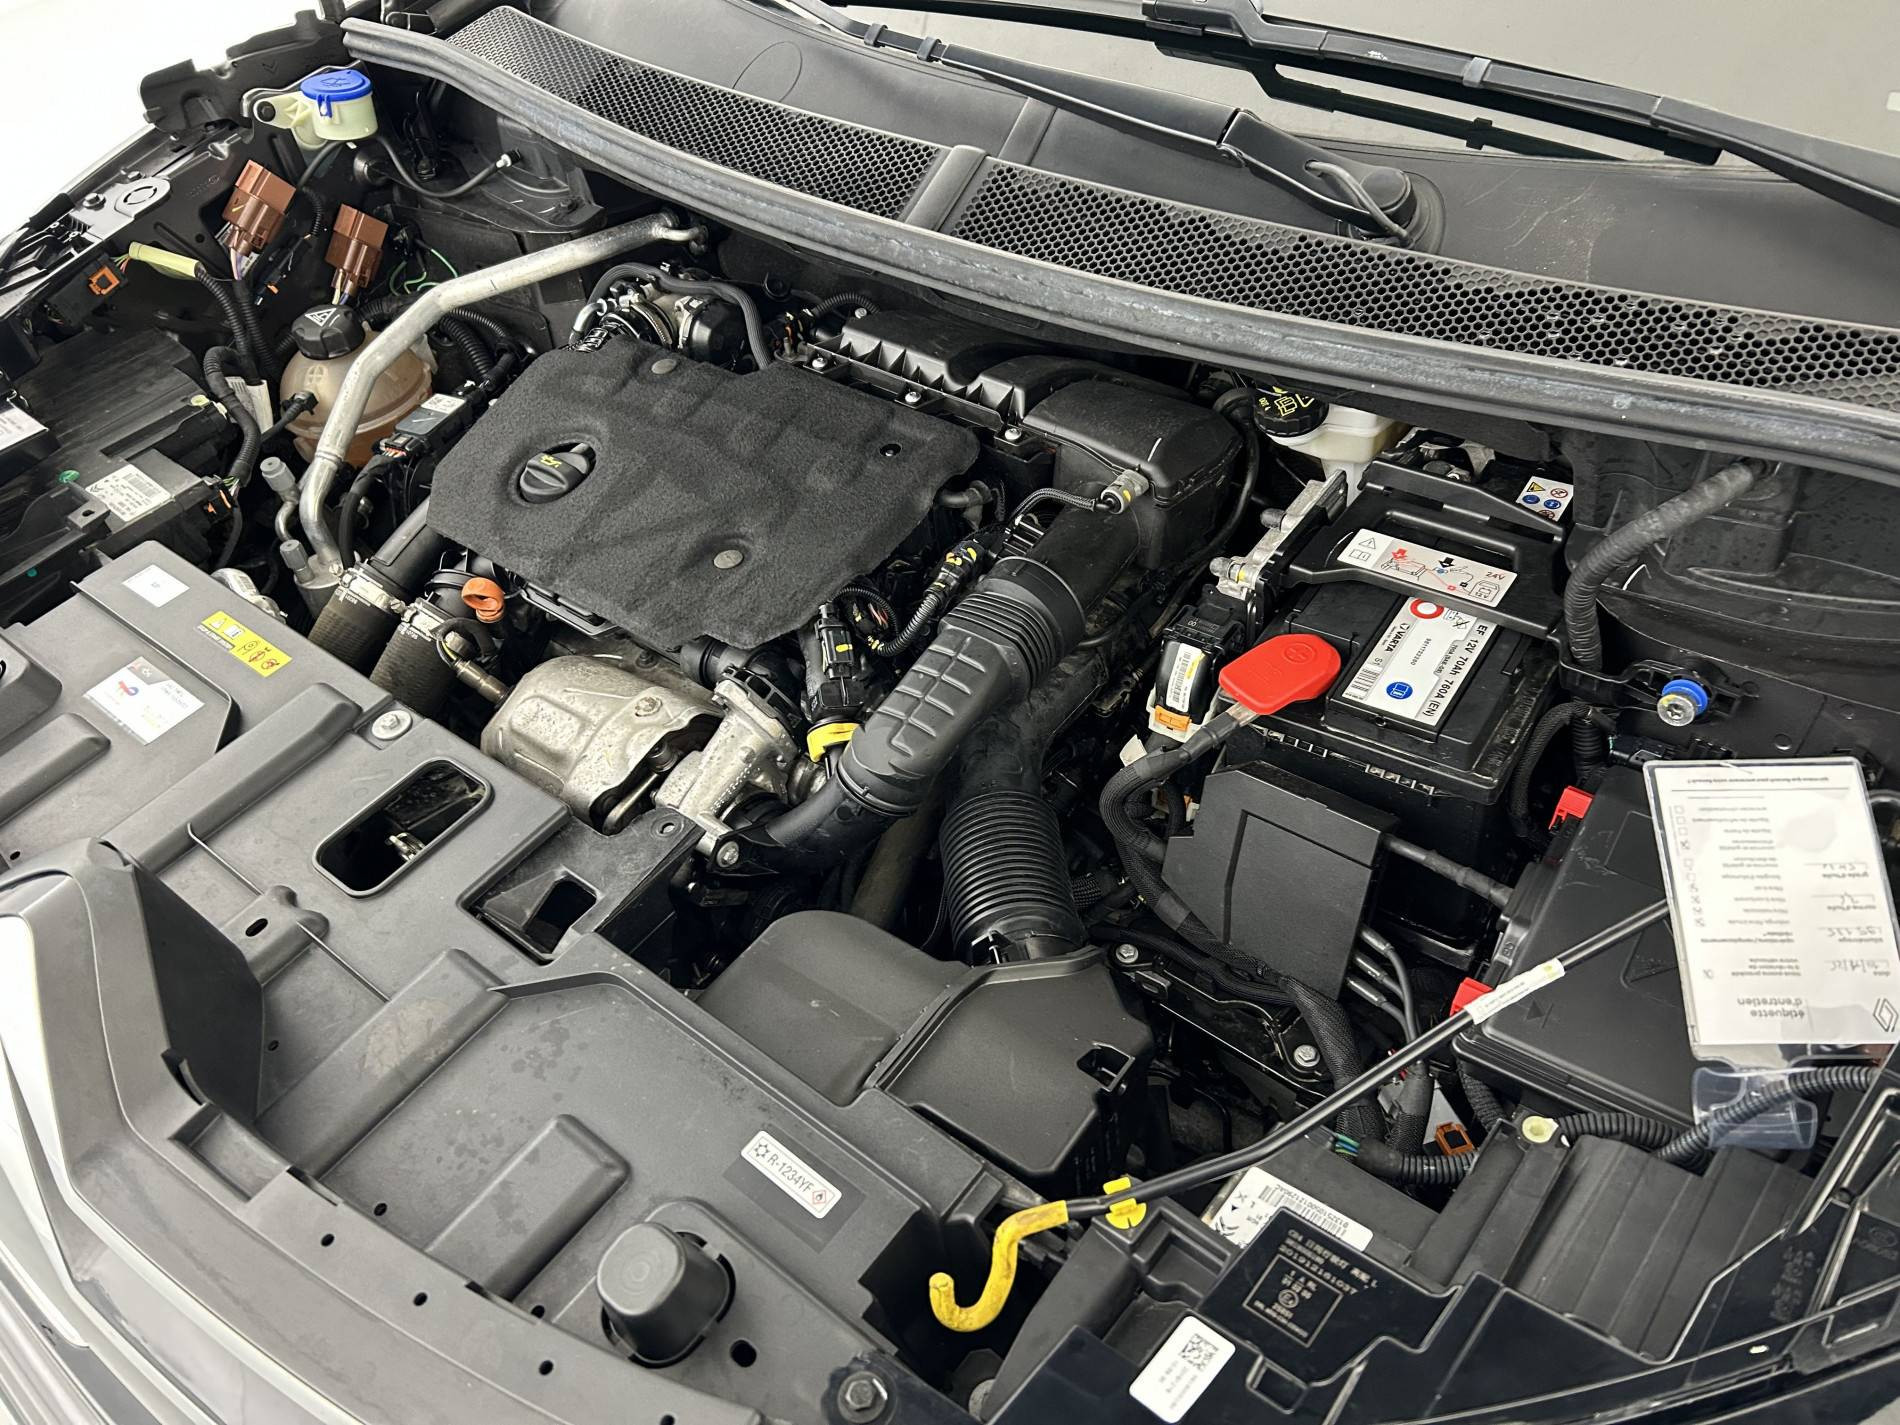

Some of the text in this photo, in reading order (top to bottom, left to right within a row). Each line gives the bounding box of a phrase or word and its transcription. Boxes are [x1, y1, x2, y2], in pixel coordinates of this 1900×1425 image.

[1485, 570, 1506, 581] 24V
[1384, 630, 1409, 653] VARTA
[1422, 624, 1489, 718] EF 12V 70Ah 760A (EN)
[1737, 997, 1803, 1009] d'entretien
[1750, 1008, 1806, 1021] étiquette
[767, 1153, 815, 1193] R-1234YF
